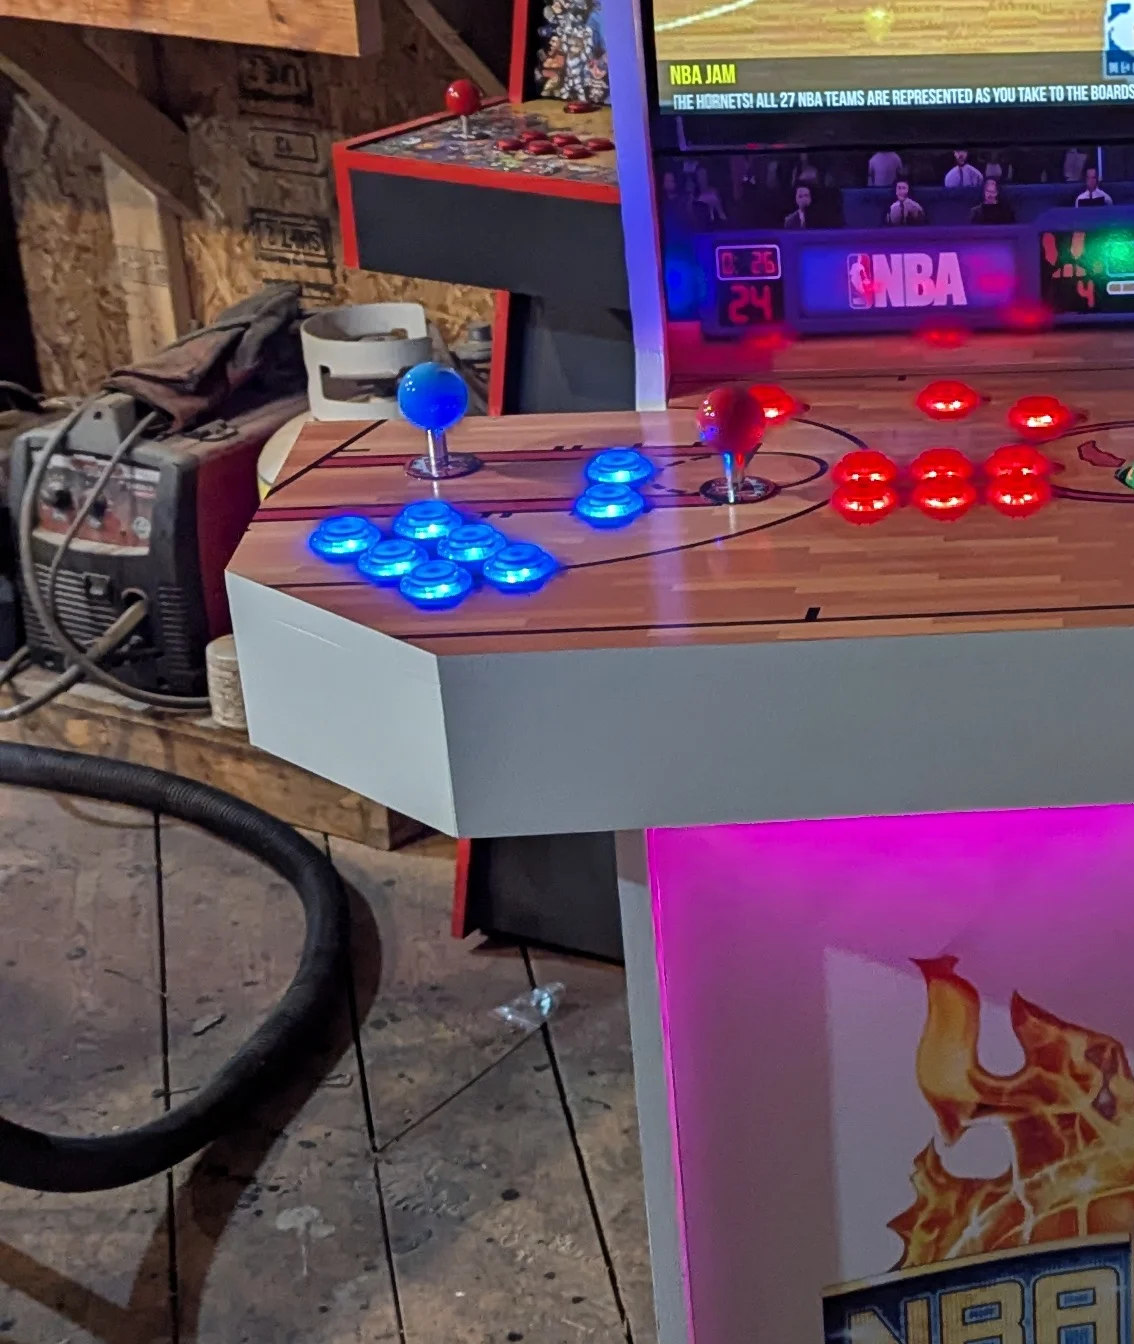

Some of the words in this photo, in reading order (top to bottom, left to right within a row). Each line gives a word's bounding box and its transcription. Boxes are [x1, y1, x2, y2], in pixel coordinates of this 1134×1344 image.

[669, 64, 702, 86] NBA
[705, 64, 736, 85] JAM
[756, 92, 778, 109] ALL
[780, 91, 796, 109] 27
[798, 90, 823, 108] NBA
[824, 89, 865, 107] TEAMS
[868, 90, 890, 106] ARE
[892, 88, 973, 106] REPRESENTED
[975, 87, 991, 104] AS
[993, 87, 1016, 103] YOU
[1017, 86, 1047, 103] TAKE
[1048, 86, 1064, 102] TO
[1066, 85, 1088, 101] THE
[751, 250, 776, 275] 26
[871, 252, 968, 308] NBA
[728, 284, 773, 325] 24
